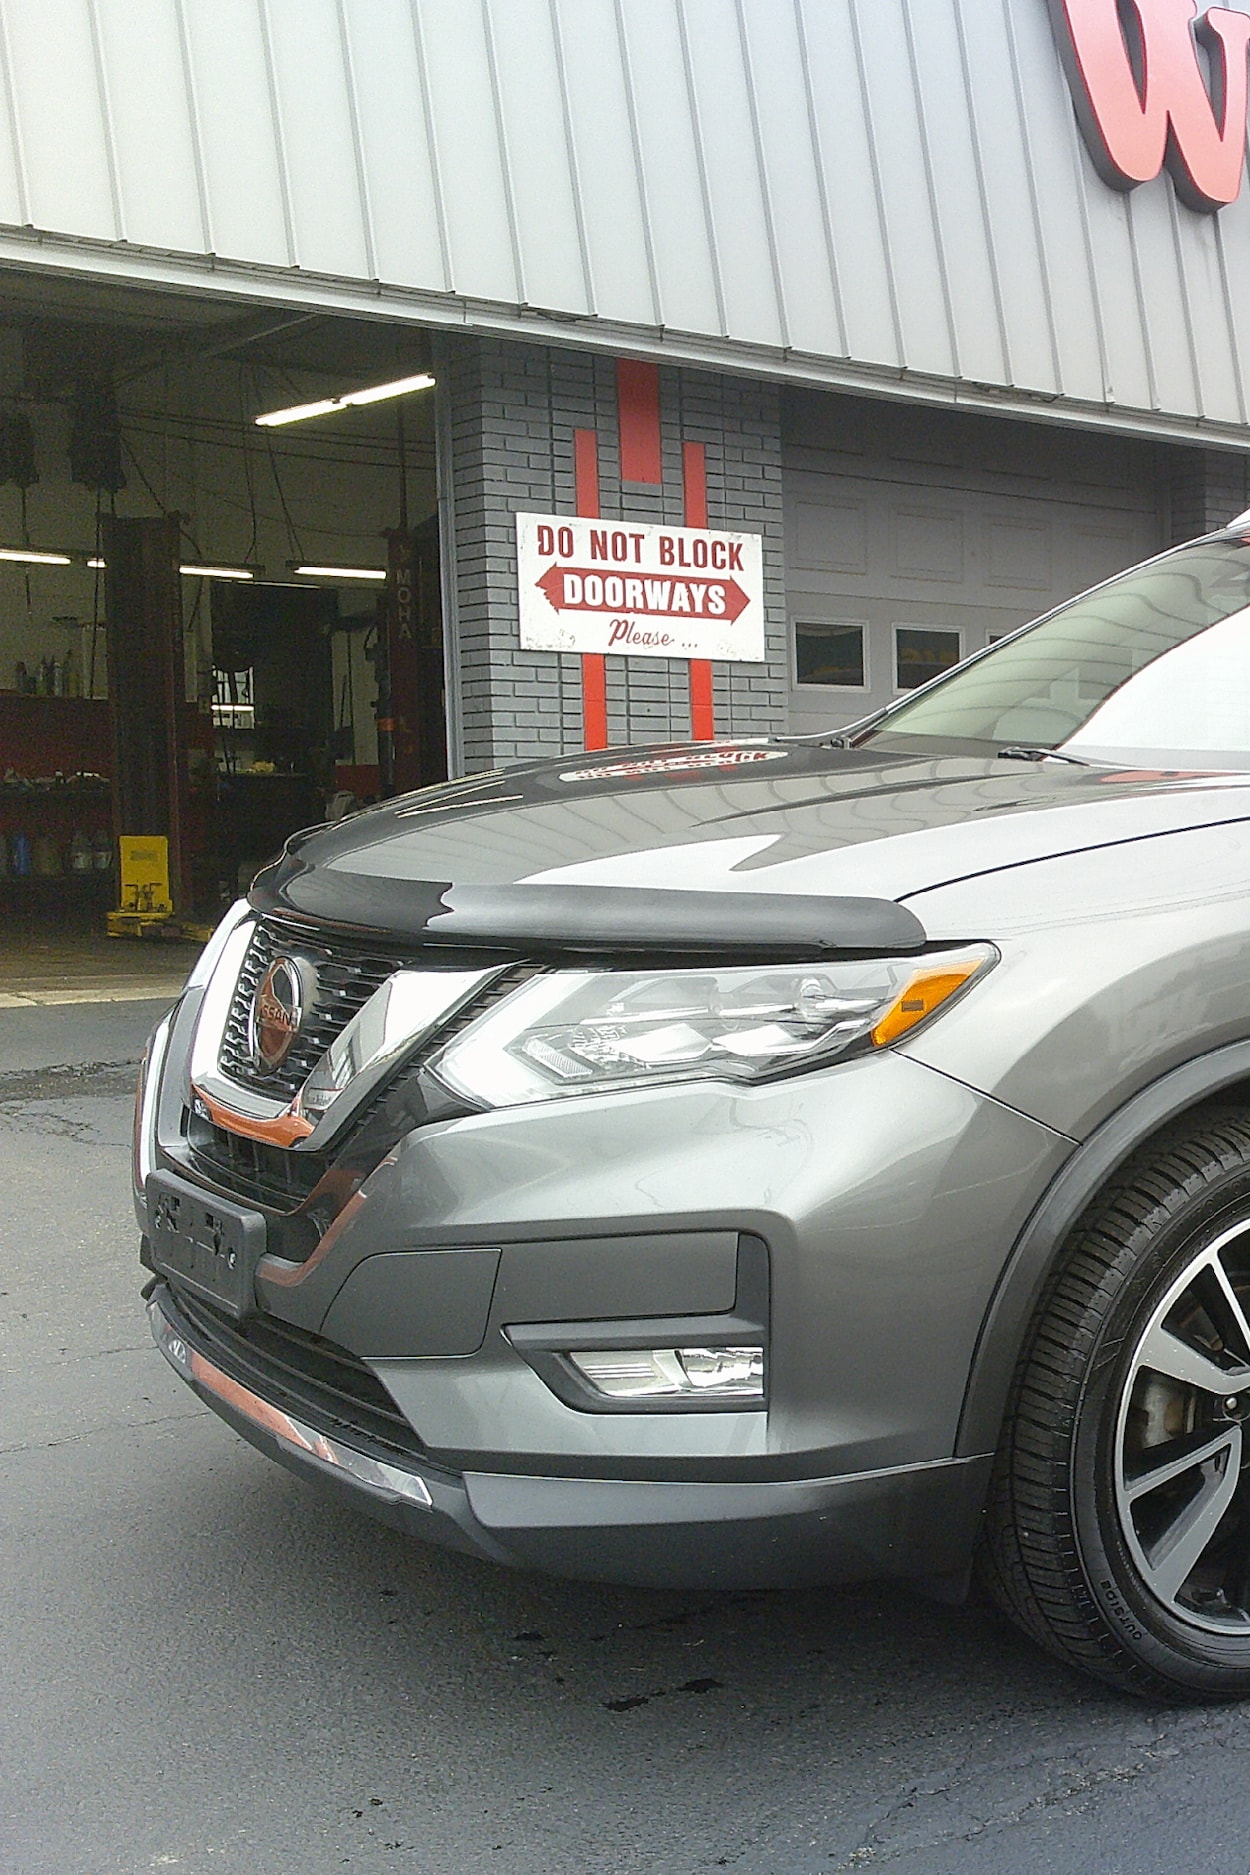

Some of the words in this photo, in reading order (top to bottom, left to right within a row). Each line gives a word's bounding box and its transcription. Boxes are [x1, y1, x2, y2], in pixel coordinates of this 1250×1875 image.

[537, 525, 574, 558] DO
[589, 529, 645, 563] NOT
[659, 535, 745, 571] BLOCK
[563, 572, 727, 616] DOORWAYS
[608, 618, 675, 647] Please
[1099, 1579, 1143, 1641] OUTSIDE
